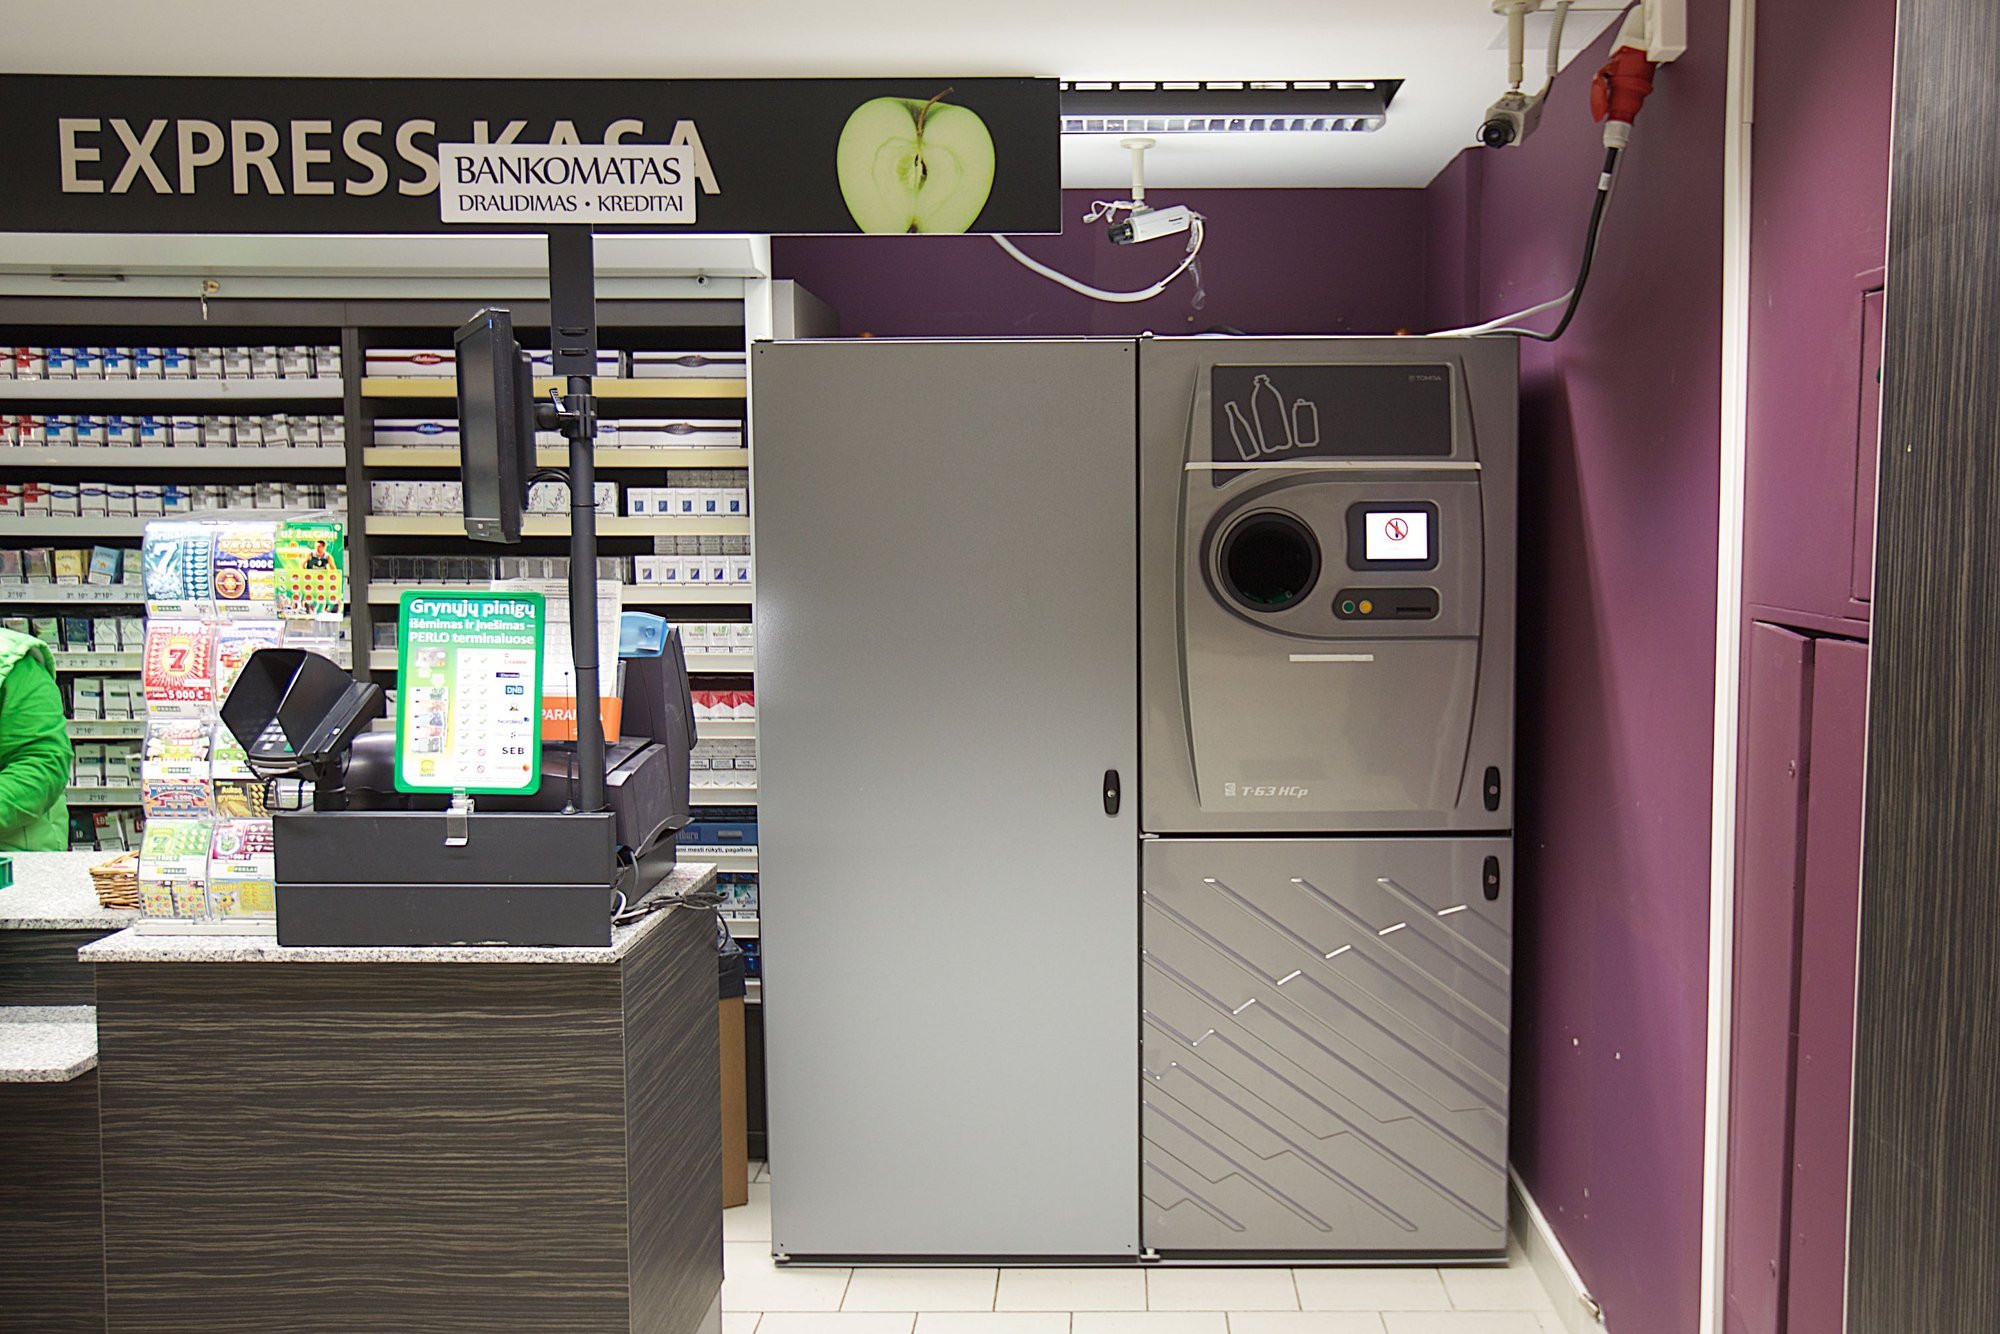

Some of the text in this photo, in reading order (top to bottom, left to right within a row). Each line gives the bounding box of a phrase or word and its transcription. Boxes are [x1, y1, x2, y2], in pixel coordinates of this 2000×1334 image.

[58, 116, 441, 197] EXPRESS
[454, 155, 682, 185] BANKOMATAS
[458, 194, 683, 212] DRAUDIMAS KREDITAI
[409, 598, 536, 618] Grynųjų pinigų
[465, 619, 475, 629] ir
[409, 632, 535, 644] PERLO terminaluose
[169, 649, 188, 671] 7
[506, 686, 524, 694] DNB
[502, 747, 525, 755] SEB
[1278, 786, 1309, 800] HCp
